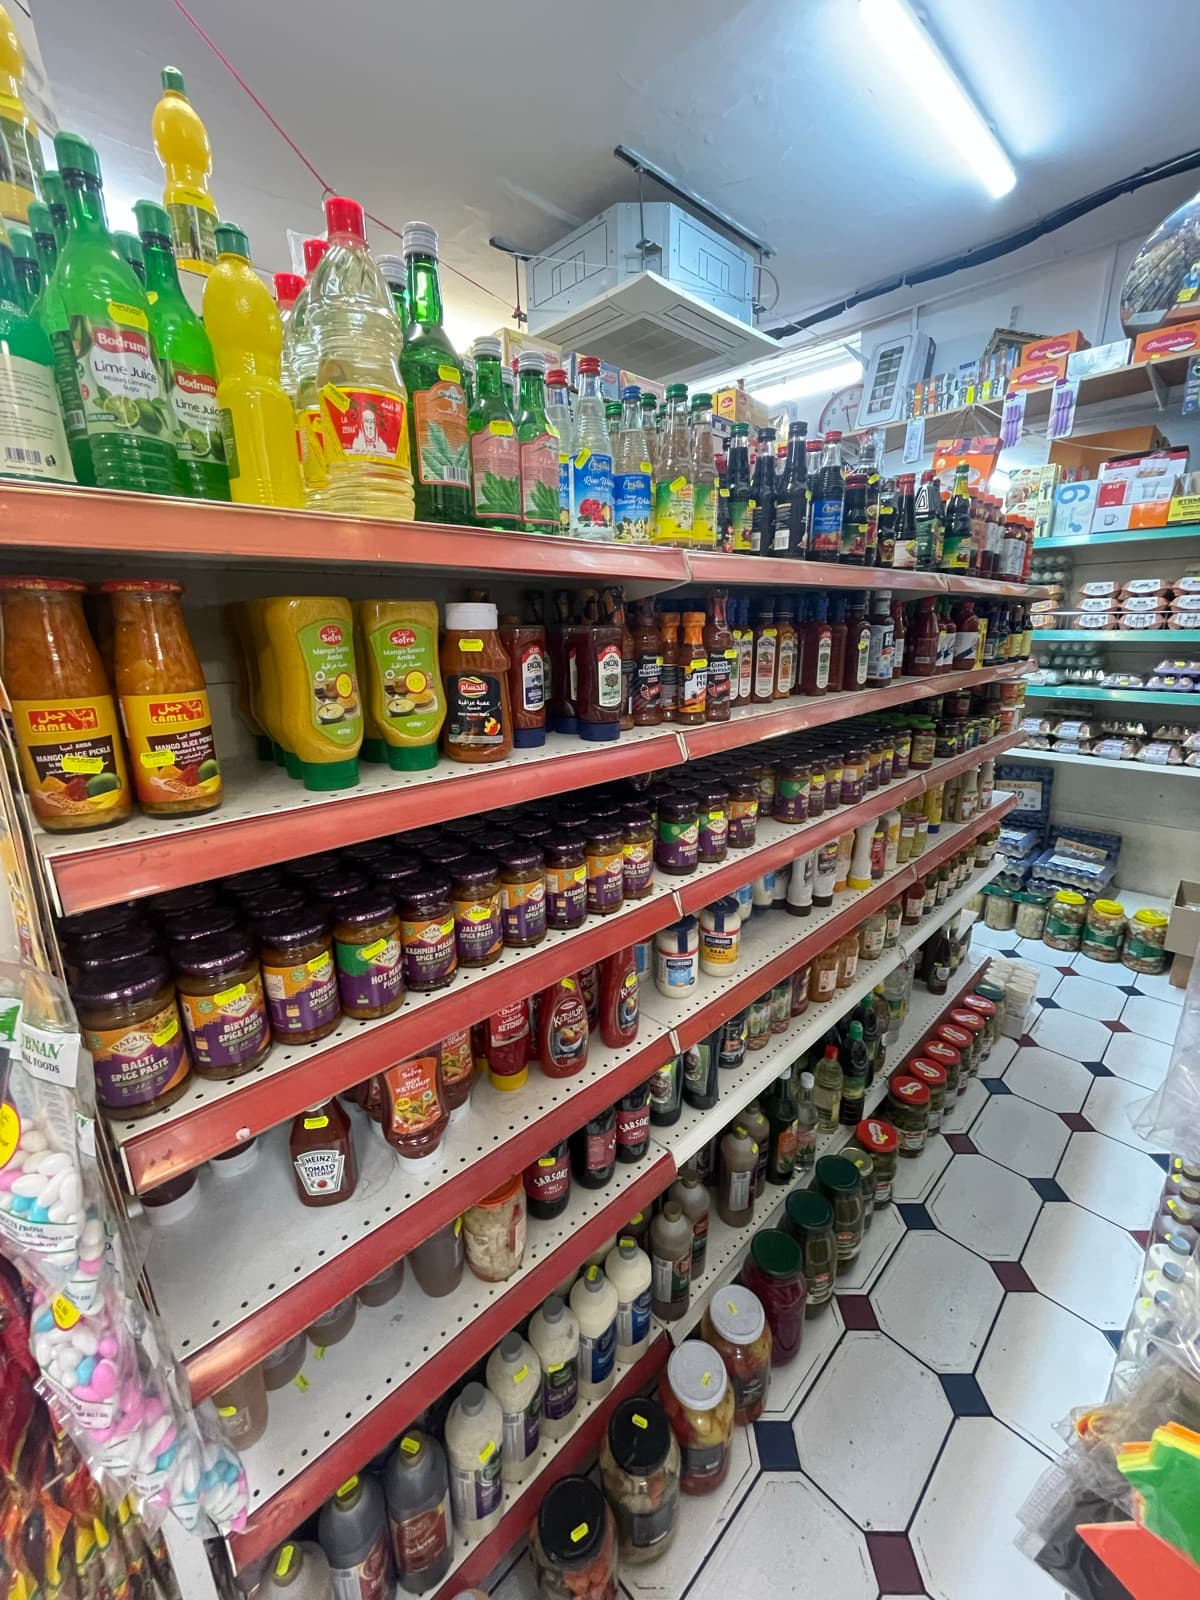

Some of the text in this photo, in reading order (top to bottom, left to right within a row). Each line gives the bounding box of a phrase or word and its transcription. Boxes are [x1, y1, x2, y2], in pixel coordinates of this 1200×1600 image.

[97, 332, 148, 355] Bodrum
[94, 360, 158, 384] Lime Juice
[178, 375, 217, 393] Bodrum
[175, 398, 201, 413] Lime
[391, 636, 415, 645] Sofra
[460, 683, 487, 691] الحسام
[152, 714, 190, 723] CAMEL
[31, 723, 75, 732] CAMEL
[154, 743, 181, 752] MANGO
[181, 739, 199, 748] SLICE
[35, 754, 63, 762] MANGO
[88, 745, 111, 756] PICKLE
[371, 972, 387, 985] HOT
[243, 1016, 263, 1036] PASTE
[497, 1016, 524, 1033] KETCHUP
[33, 1057, 60, 1074] FOODS
[140, 1057, 169, 1076] PASTE
[396, 1078, 431, 1093] KETCHUP
[405, 1077, 421, 1087] HOT
[305, 1154, 331, 1164] HEINZ
[304, 1163, 336, 1173] TOMATO
[306, 1169, 335, 1178] KETCHUP
